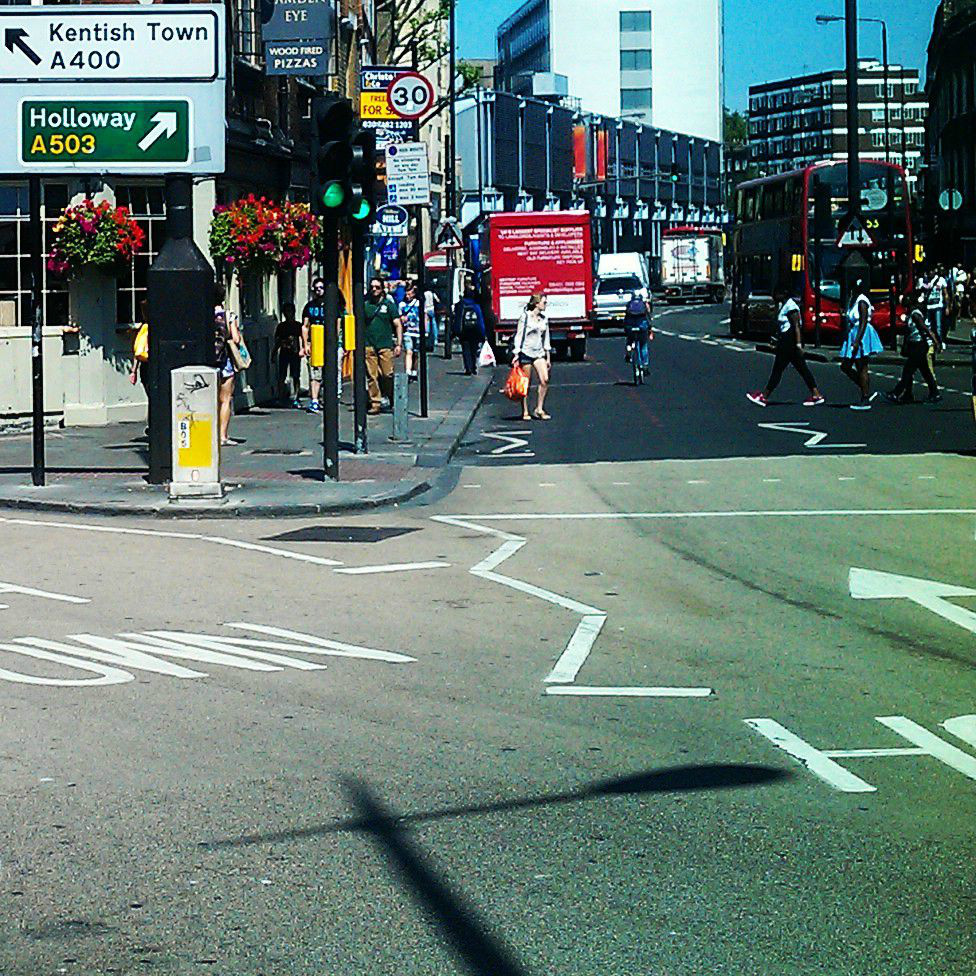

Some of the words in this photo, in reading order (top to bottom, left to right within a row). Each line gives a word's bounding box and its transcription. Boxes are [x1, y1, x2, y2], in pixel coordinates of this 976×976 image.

[285, 10, 308, 22] EYE
[50, 22, 135, 42] Kentish
[147, 22, 208, 41] Town
[51, 50, 120, 70] A400
[269, 47, 298, 55] WOOD
[300, 46, 323, 54] FIRED
[274, 58, 317, 68] PIZZAS
[394, 86, 427, 106] 30
[30, 107, 136, 131] Holloway
[363, 105, 382, 115] FOR
[30, 134, 96, 155] A503
